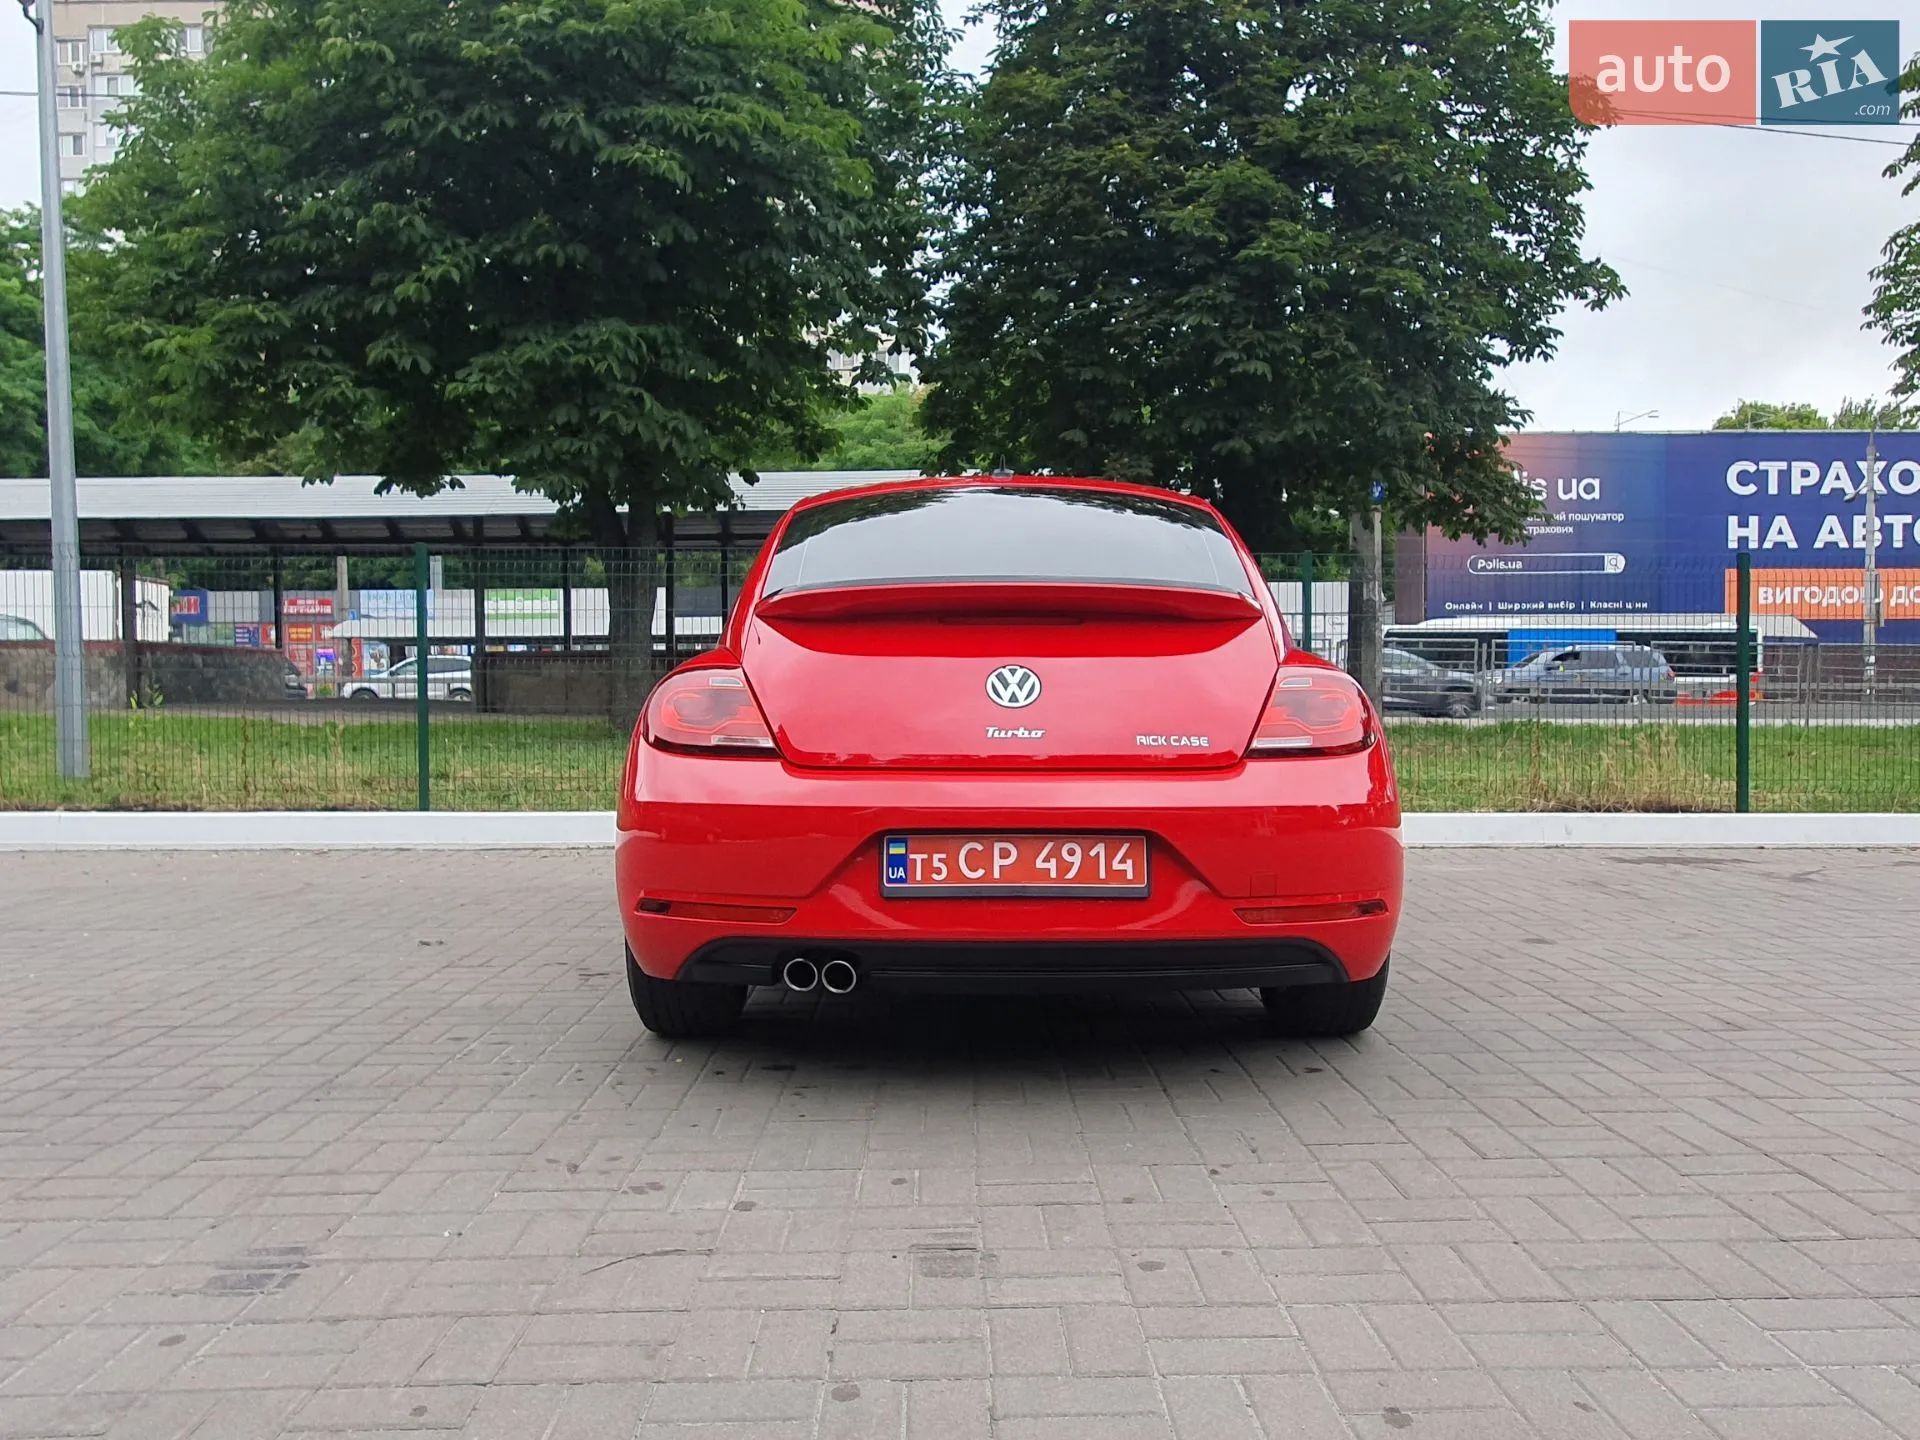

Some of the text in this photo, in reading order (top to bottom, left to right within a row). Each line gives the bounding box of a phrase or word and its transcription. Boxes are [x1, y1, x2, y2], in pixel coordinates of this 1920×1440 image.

[1557, 477, 1600, 500] ua
[1568, 512, 1625, 523] пошукатор
[1727, 514, 1920, 549] НА АВТ
[1477, 558, 1523, 570] Polis.ua
[985, 726, 1046, 739] Turbo
[1136, 735, 1209, 747] RICK CASE
[888, 841, 1133, 881] UA T5 CP 4914
